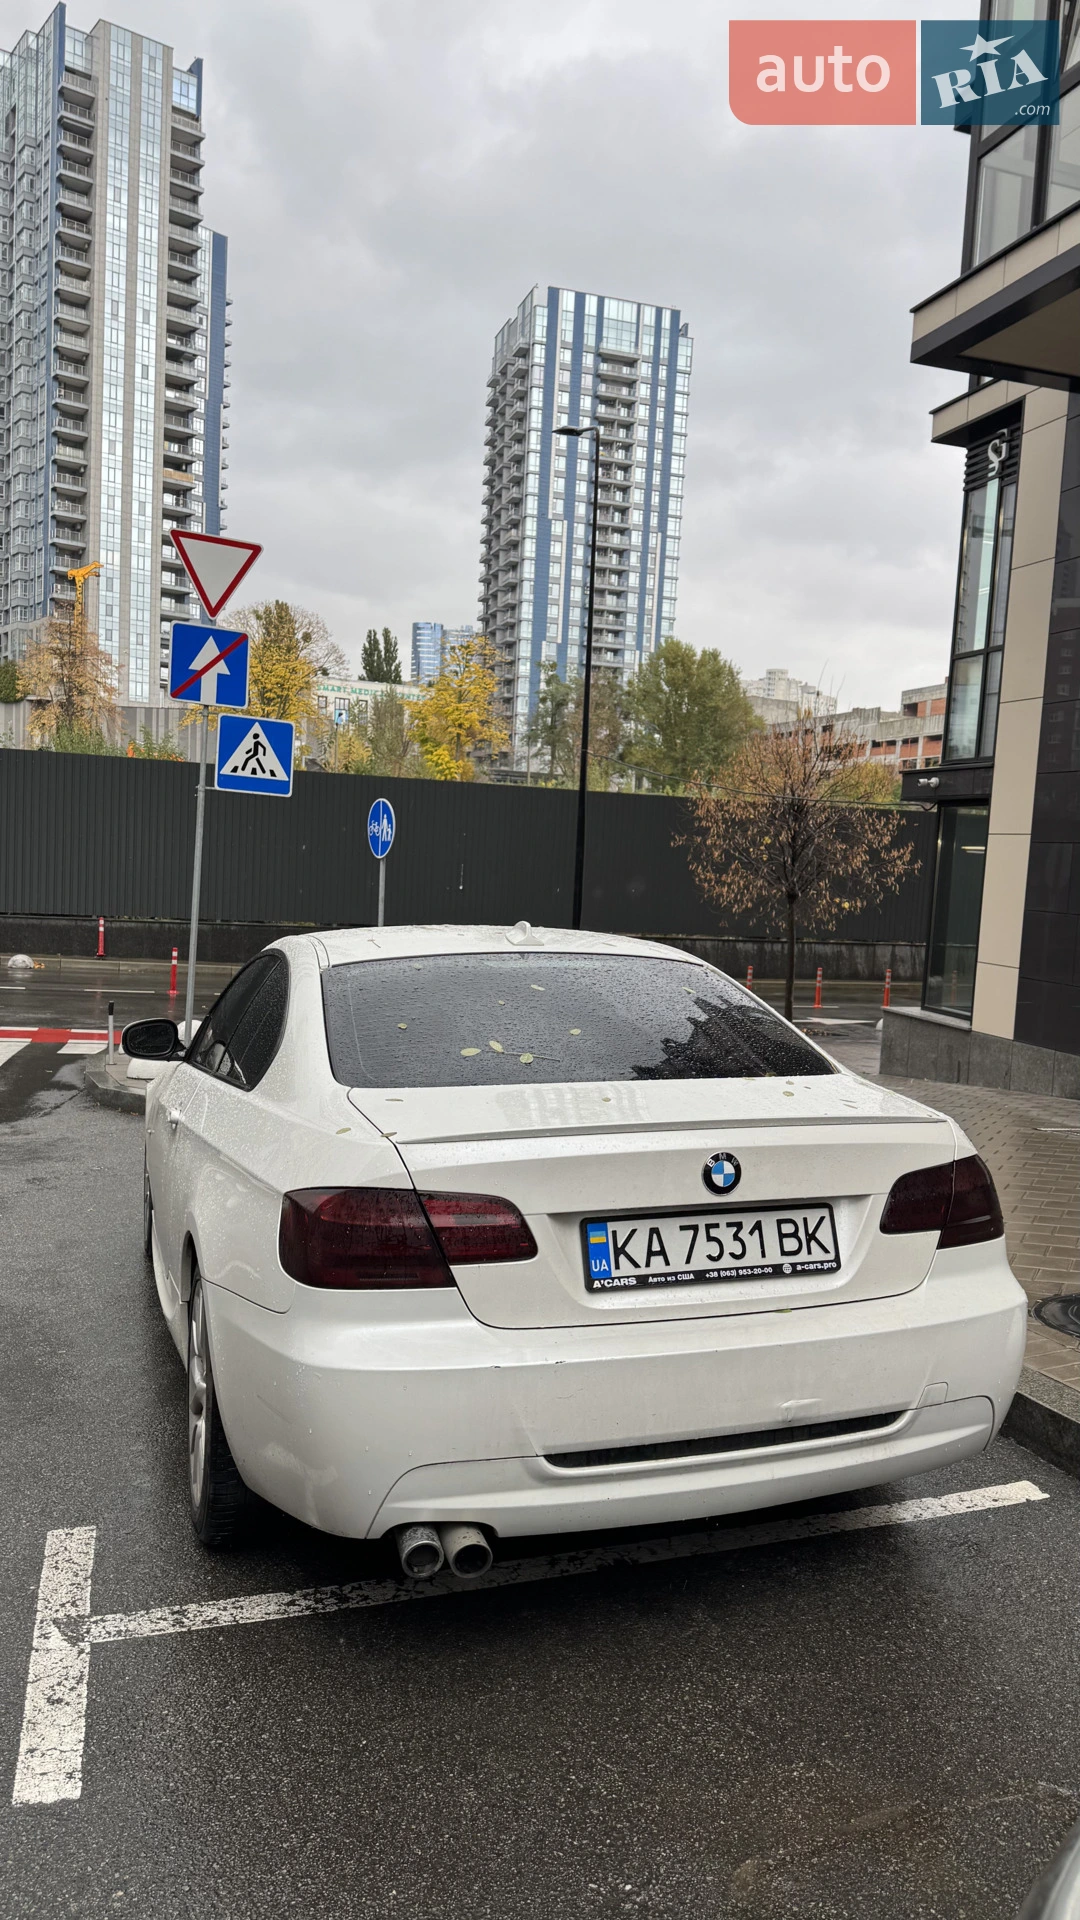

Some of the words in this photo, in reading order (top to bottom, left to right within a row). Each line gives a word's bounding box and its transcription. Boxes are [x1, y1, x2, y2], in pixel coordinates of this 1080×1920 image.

[317, 684, 347, 693] SMART
[707, 1152, 739, 1168] BMW
[611, 1227, 671, 1271] KA
[679, 1219, 766, 1265] 7531
[776, 1215, 831, 1257] BK
[591, 1258, 609, 1272] UA
[796, 1261, 837, 1271] a-cars.pro
[677, 1273, 694, 1281] США
[738, 1267, 773, 1276] 953-20-00
[593, 1277, 637, 1289] A'CARS
